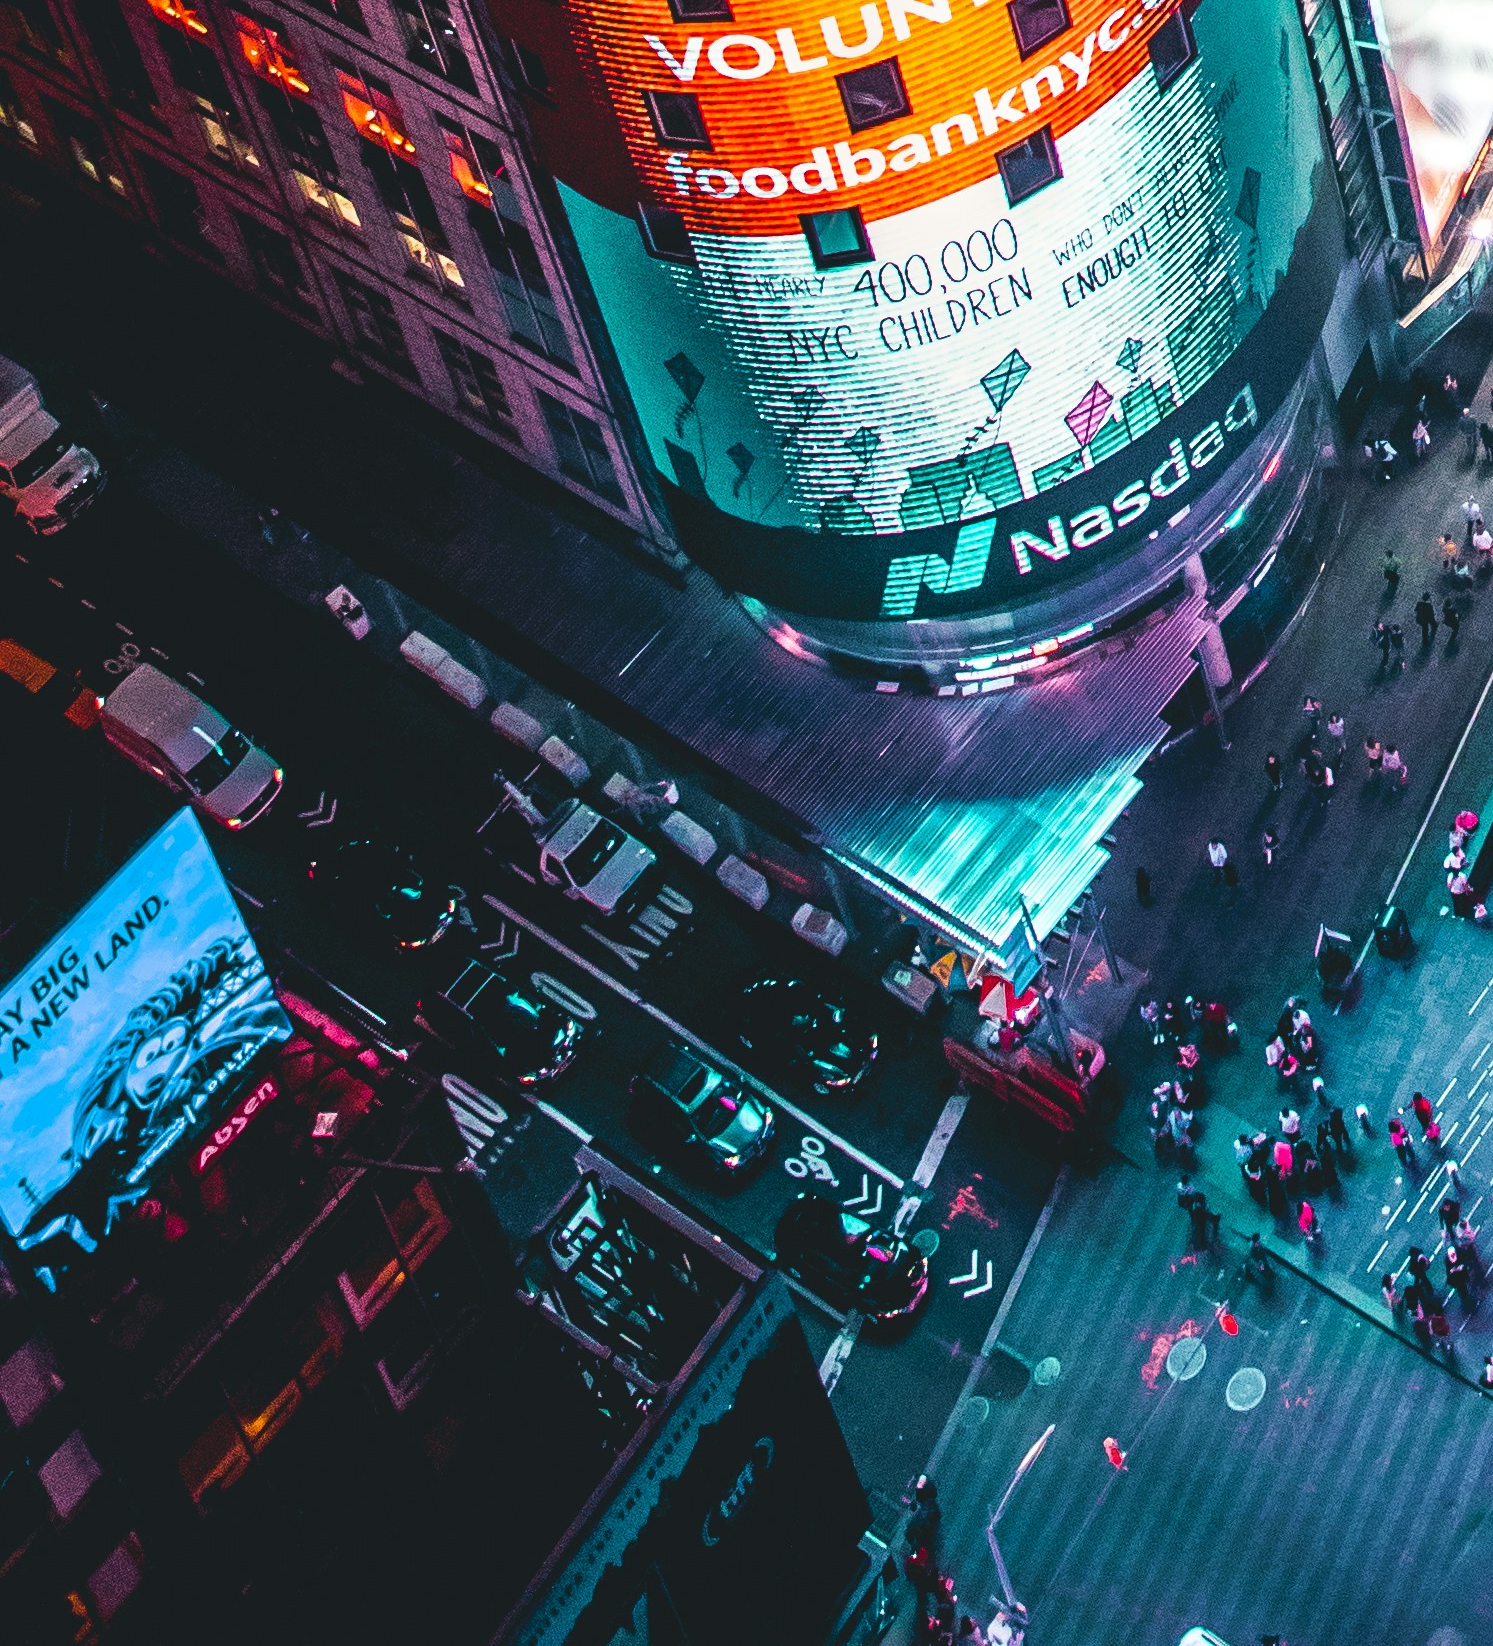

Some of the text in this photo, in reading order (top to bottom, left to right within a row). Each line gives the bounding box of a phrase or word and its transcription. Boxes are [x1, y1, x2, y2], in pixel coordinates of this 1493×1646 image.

[852, 218, 1020, 309] 400,000
[783, 319, 860, 365] NYC
[880, 271, 1035, 357] CHILDREN
[1010, 382, 1259, 577] Nasdaq
[32, 942, 83, 998] BIG
[36, 974, 94, 1036] NEW
[90, 891, 172, 982] LAND.
